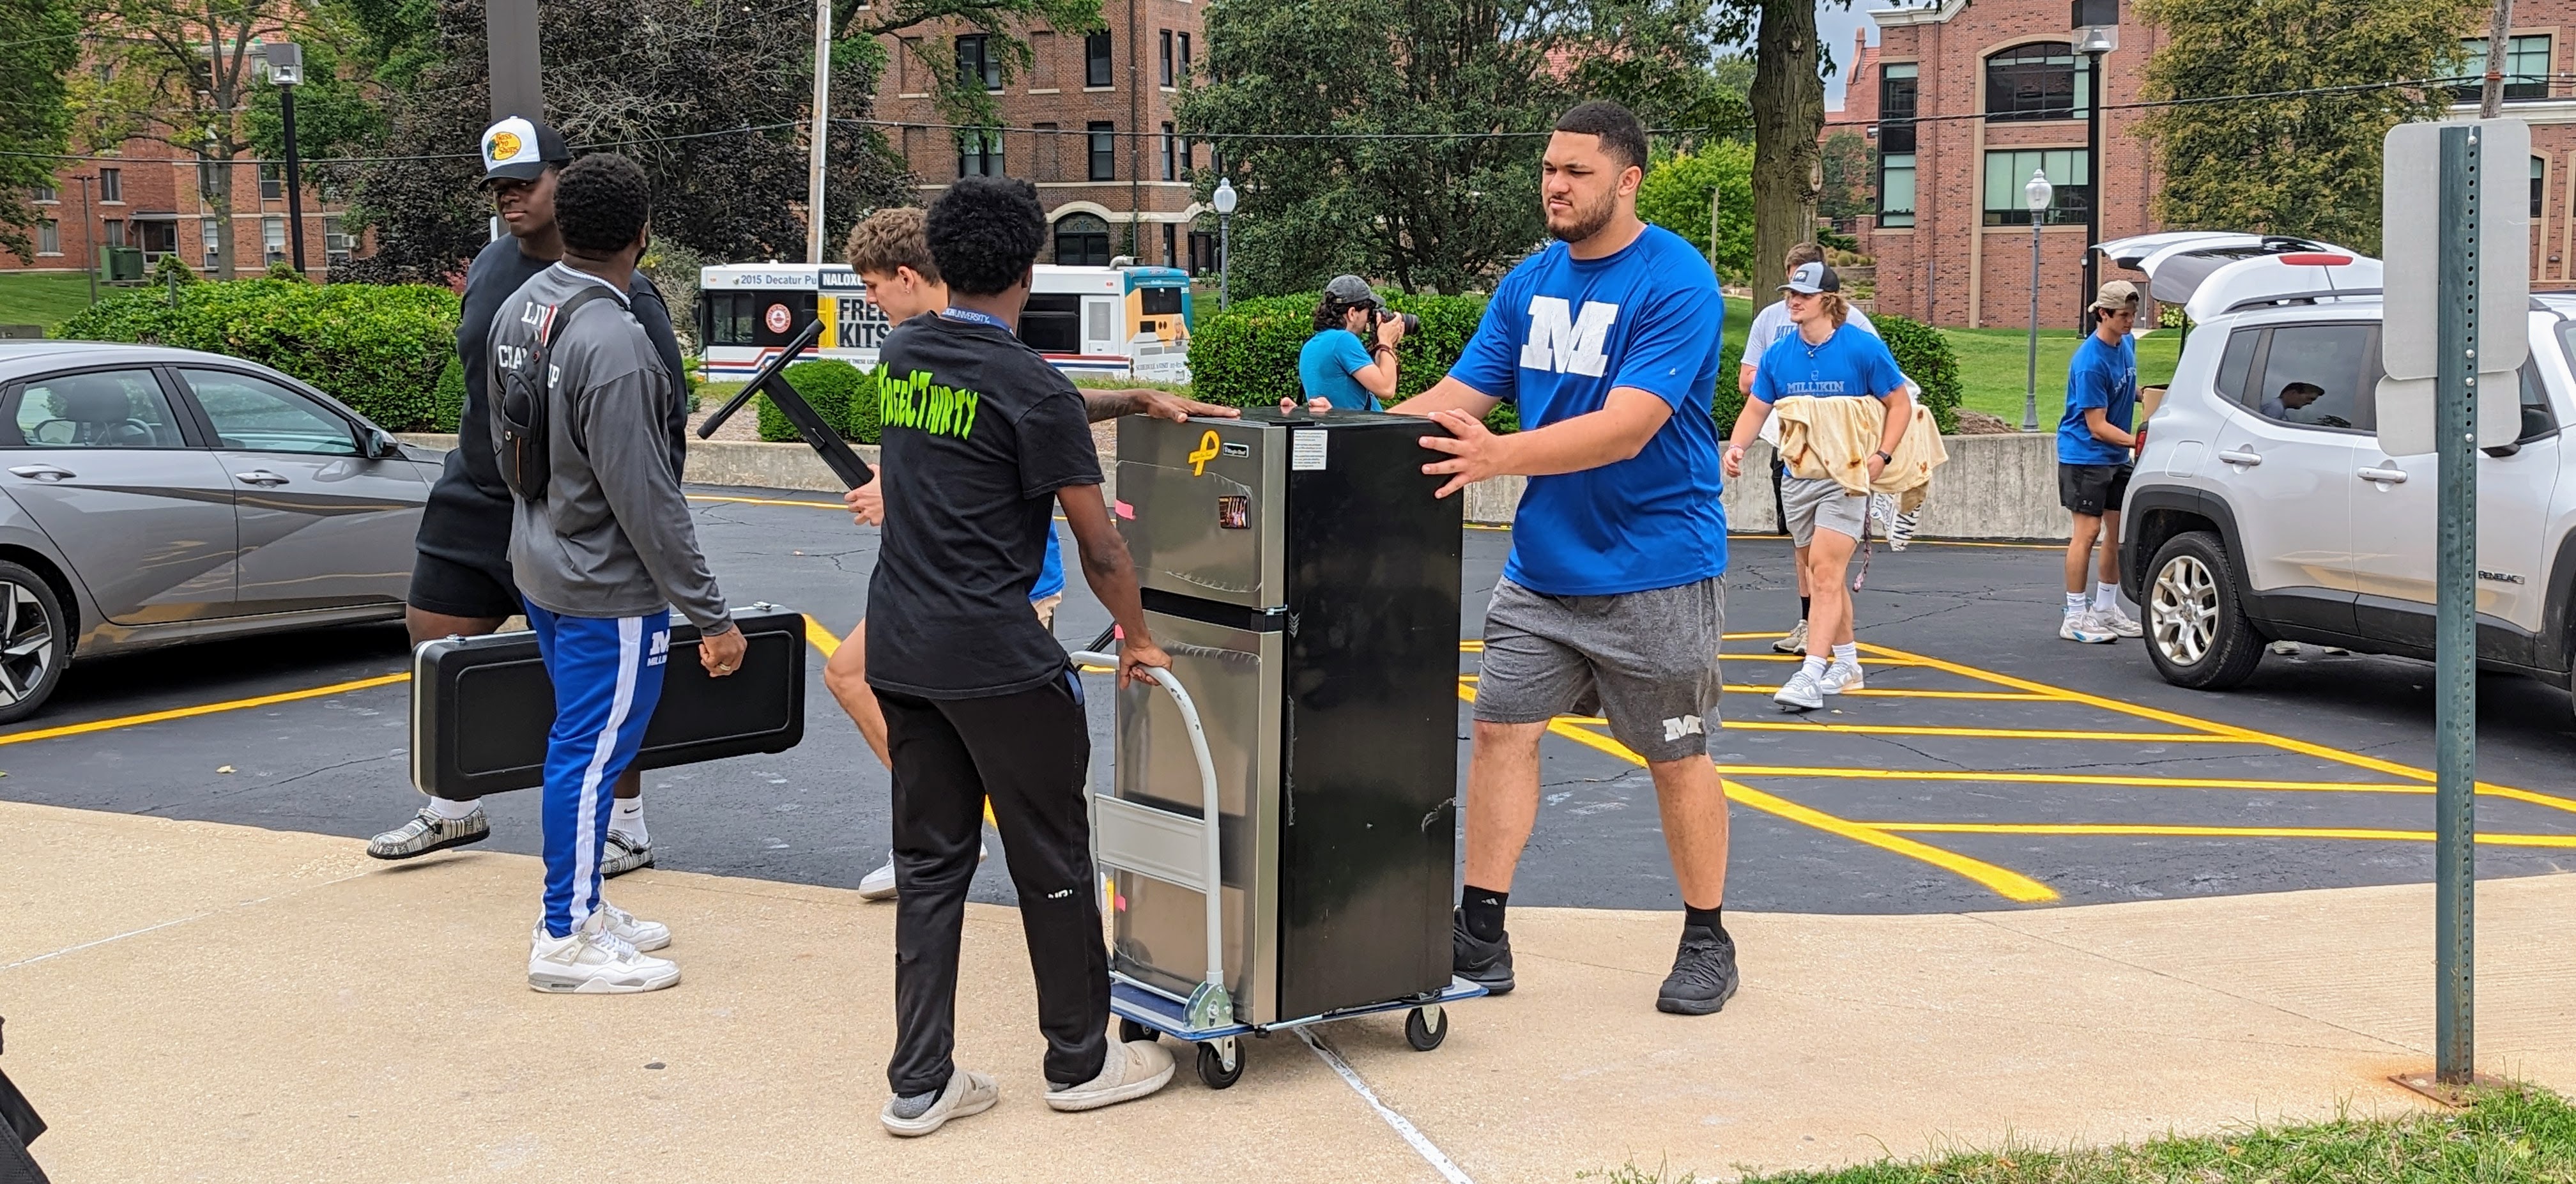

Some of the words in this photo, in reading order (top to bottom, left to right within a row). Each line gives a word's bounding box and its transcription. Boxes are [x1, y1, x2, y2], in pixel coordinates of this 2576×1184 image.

[741, 274, 762, 284] 2015
[766, 274, 802, 285] Decatur
[839, 323, 889, 348] KITS
[1519, 295, 1619, 378] M
[1787, 381, 1844, 394] MILLIKIN
[650, 629, 670, 655] M
[1662, 714, 1704, 742] M
